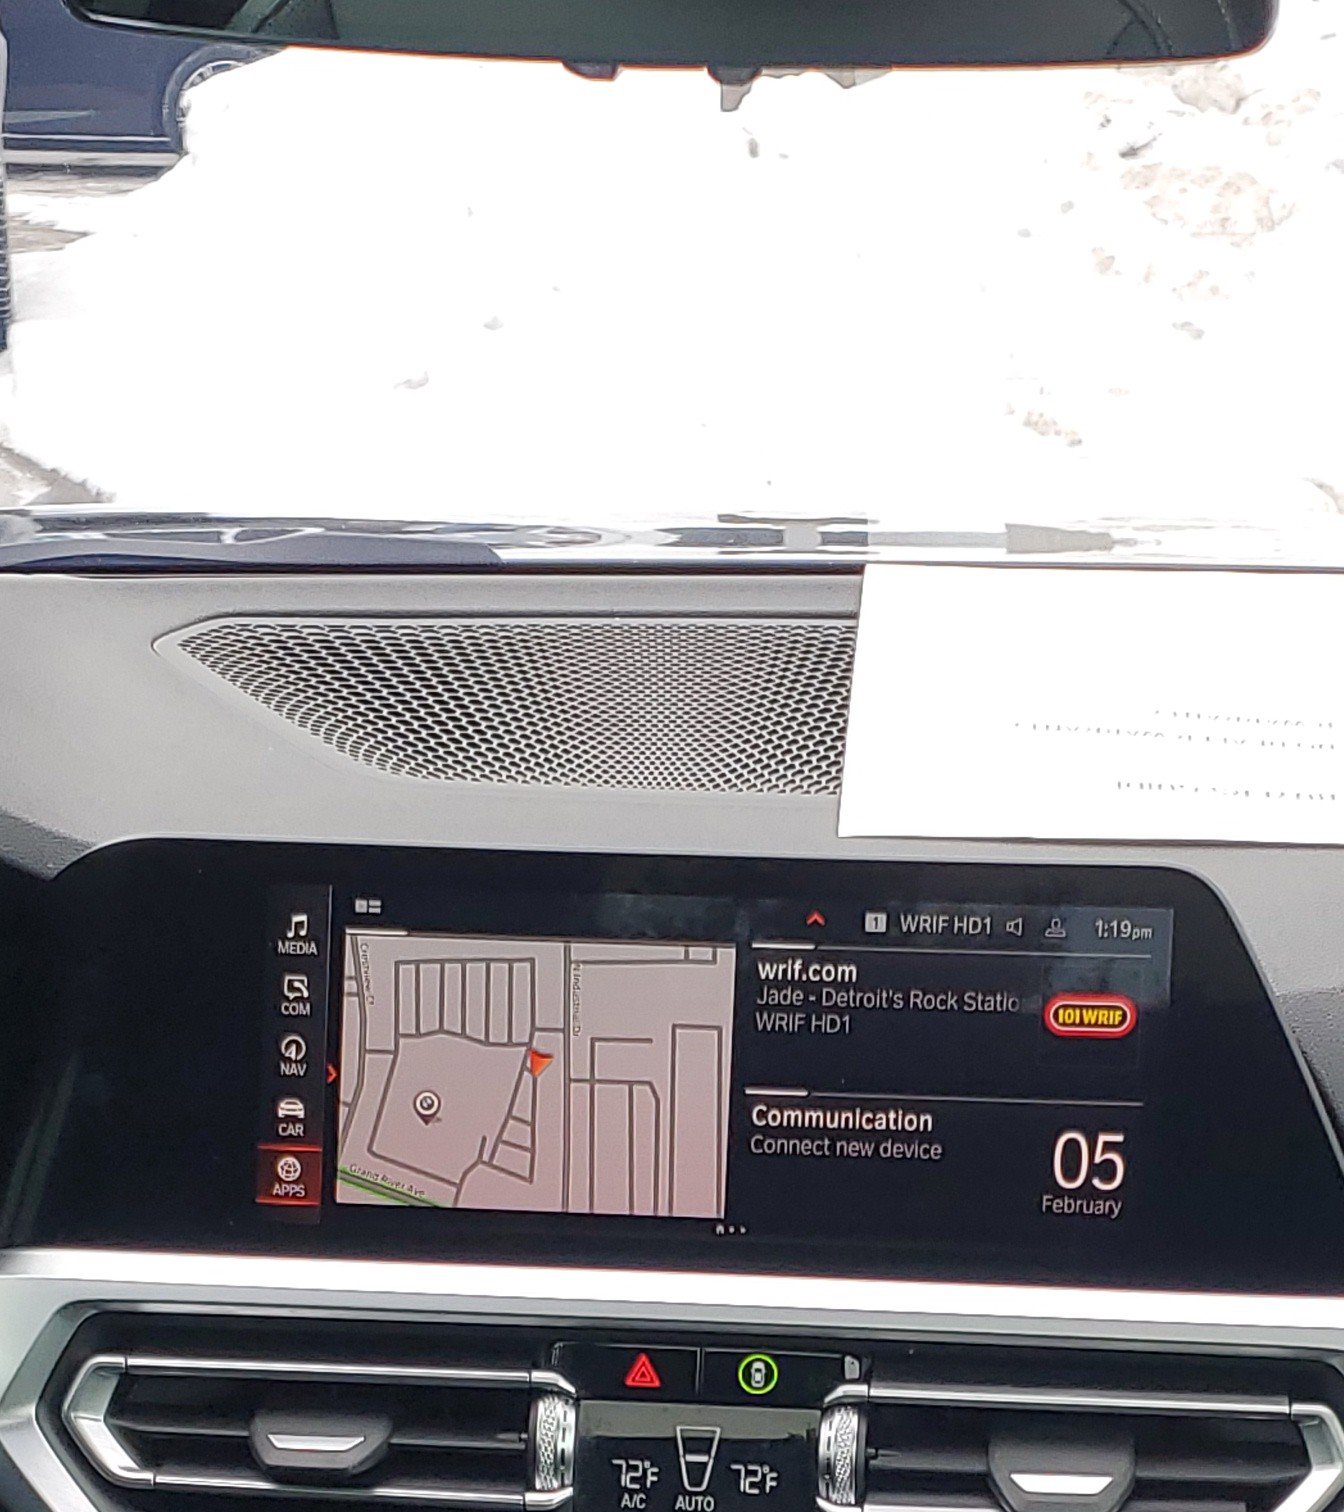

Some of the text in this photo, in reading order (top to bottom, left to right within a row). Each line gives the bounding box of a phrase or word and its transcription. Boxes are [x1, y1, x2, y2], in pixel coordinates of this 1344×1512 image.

[900, 914, 992, 936] WRIF HD1
[277, 941, 318, 956] MEDIA
[758, 959, 857, 983] wrif.com
[280, 1001, 311, 1017] COM
[756, 987, 804, 1007] Jade
[822, 989, 904, 1010] Detroit's
[910, 991, 958, 1011] Rock
[756, 1013, 851, 1035] WRIF HD1
[280, 1062, 307, 1077] NAV
[278, 1122, 304, 1137] CAR
[751, 1105, 933, 1132] Communication
[750, 1135, 943, 1160] Connect new device
[1053, 1130, 1126, 1191] 05
[272, 1182, 306, 1198] APPS
[1042, 1194, 1122, 1219] February
[620, 1494, 647, 1510] A/C
[674, 1495, 715, 1512] AUTO
